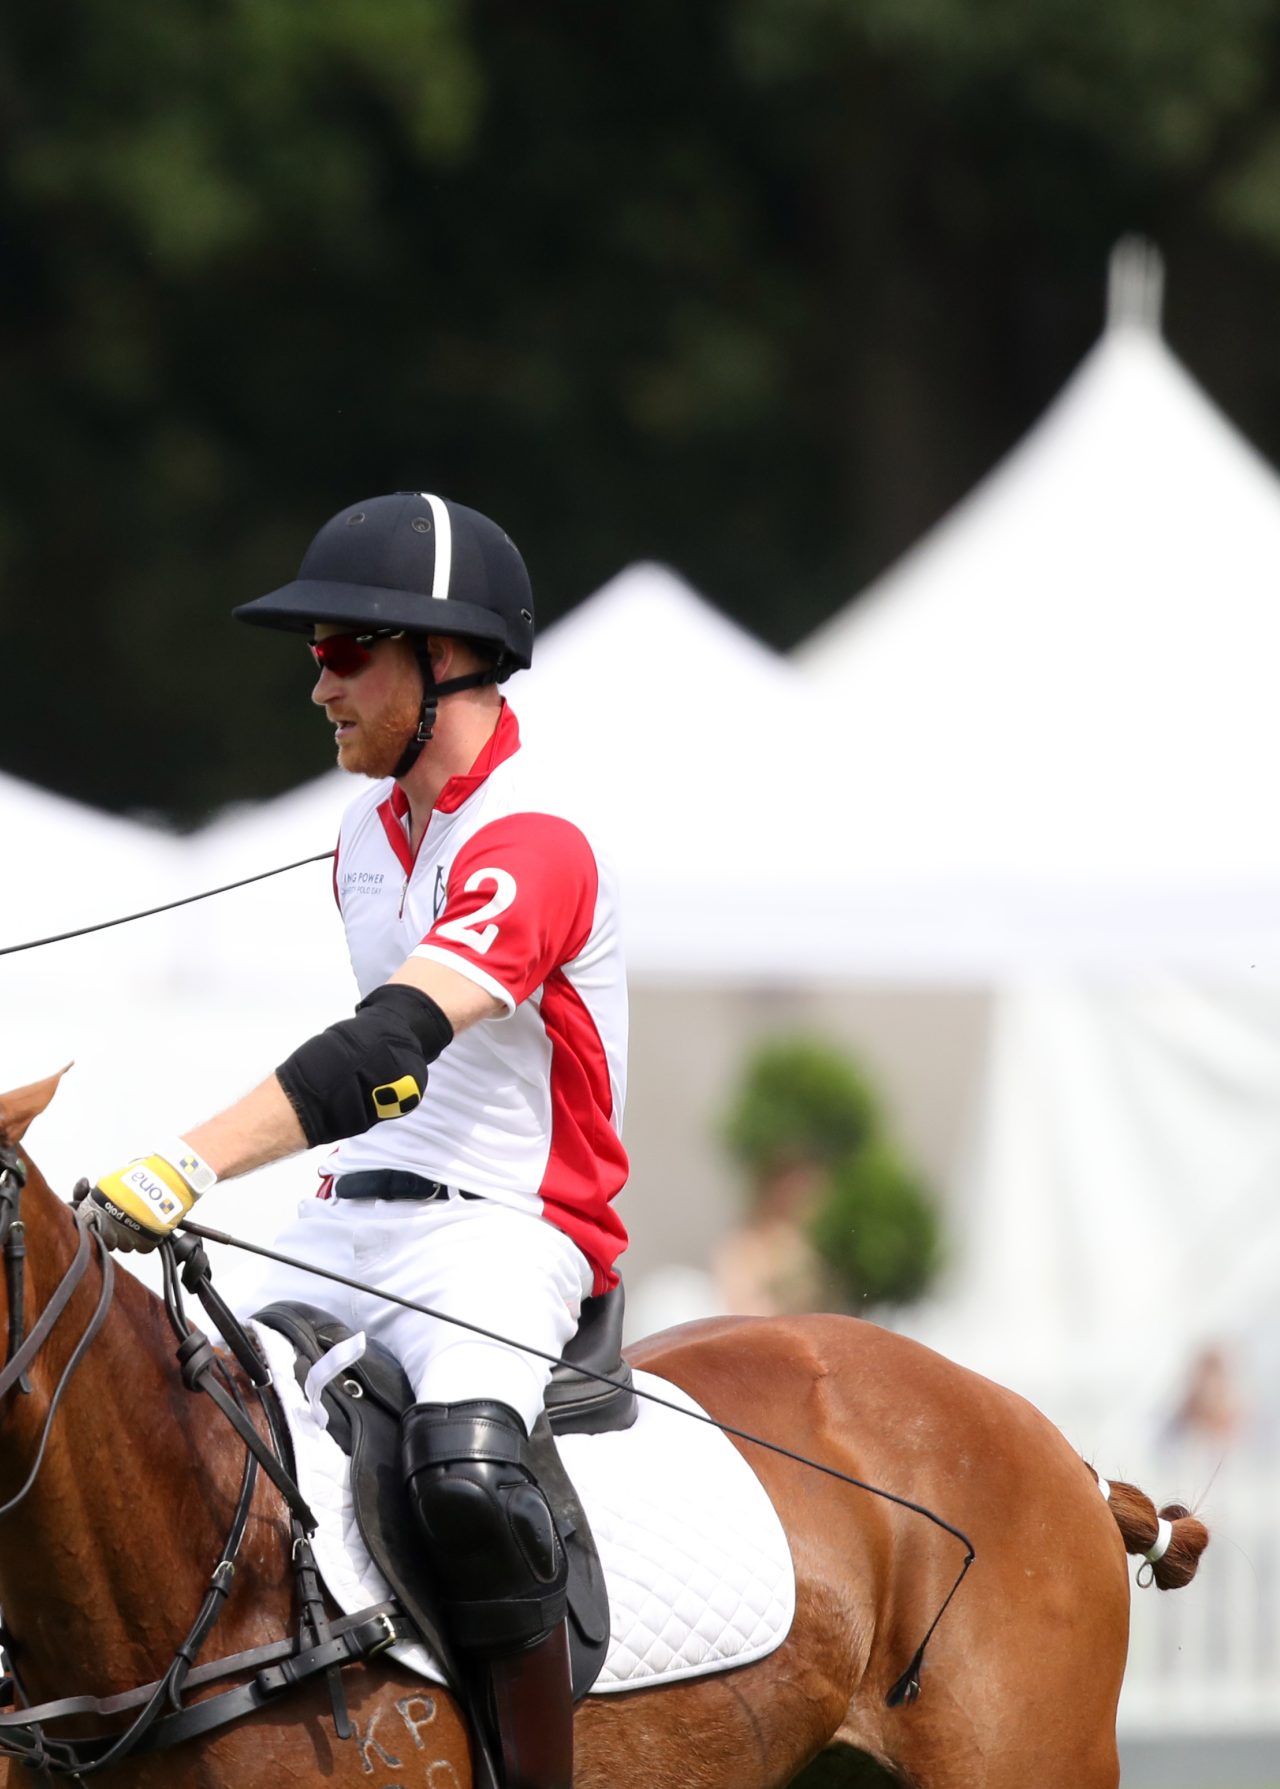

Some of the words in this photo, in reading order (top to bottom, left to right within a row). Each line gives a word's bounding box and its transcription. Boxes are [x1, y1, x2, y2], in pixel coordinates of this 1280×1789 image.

[343, 872, 357, 883] ING
[358, 872, 384, 884] POWER
[435, 867, 517, 955] 2
[131, 1171, 163, 1201] ona
[104, 1201, 125, 1220] polo
[124, 1217, 141, 1231] ona
